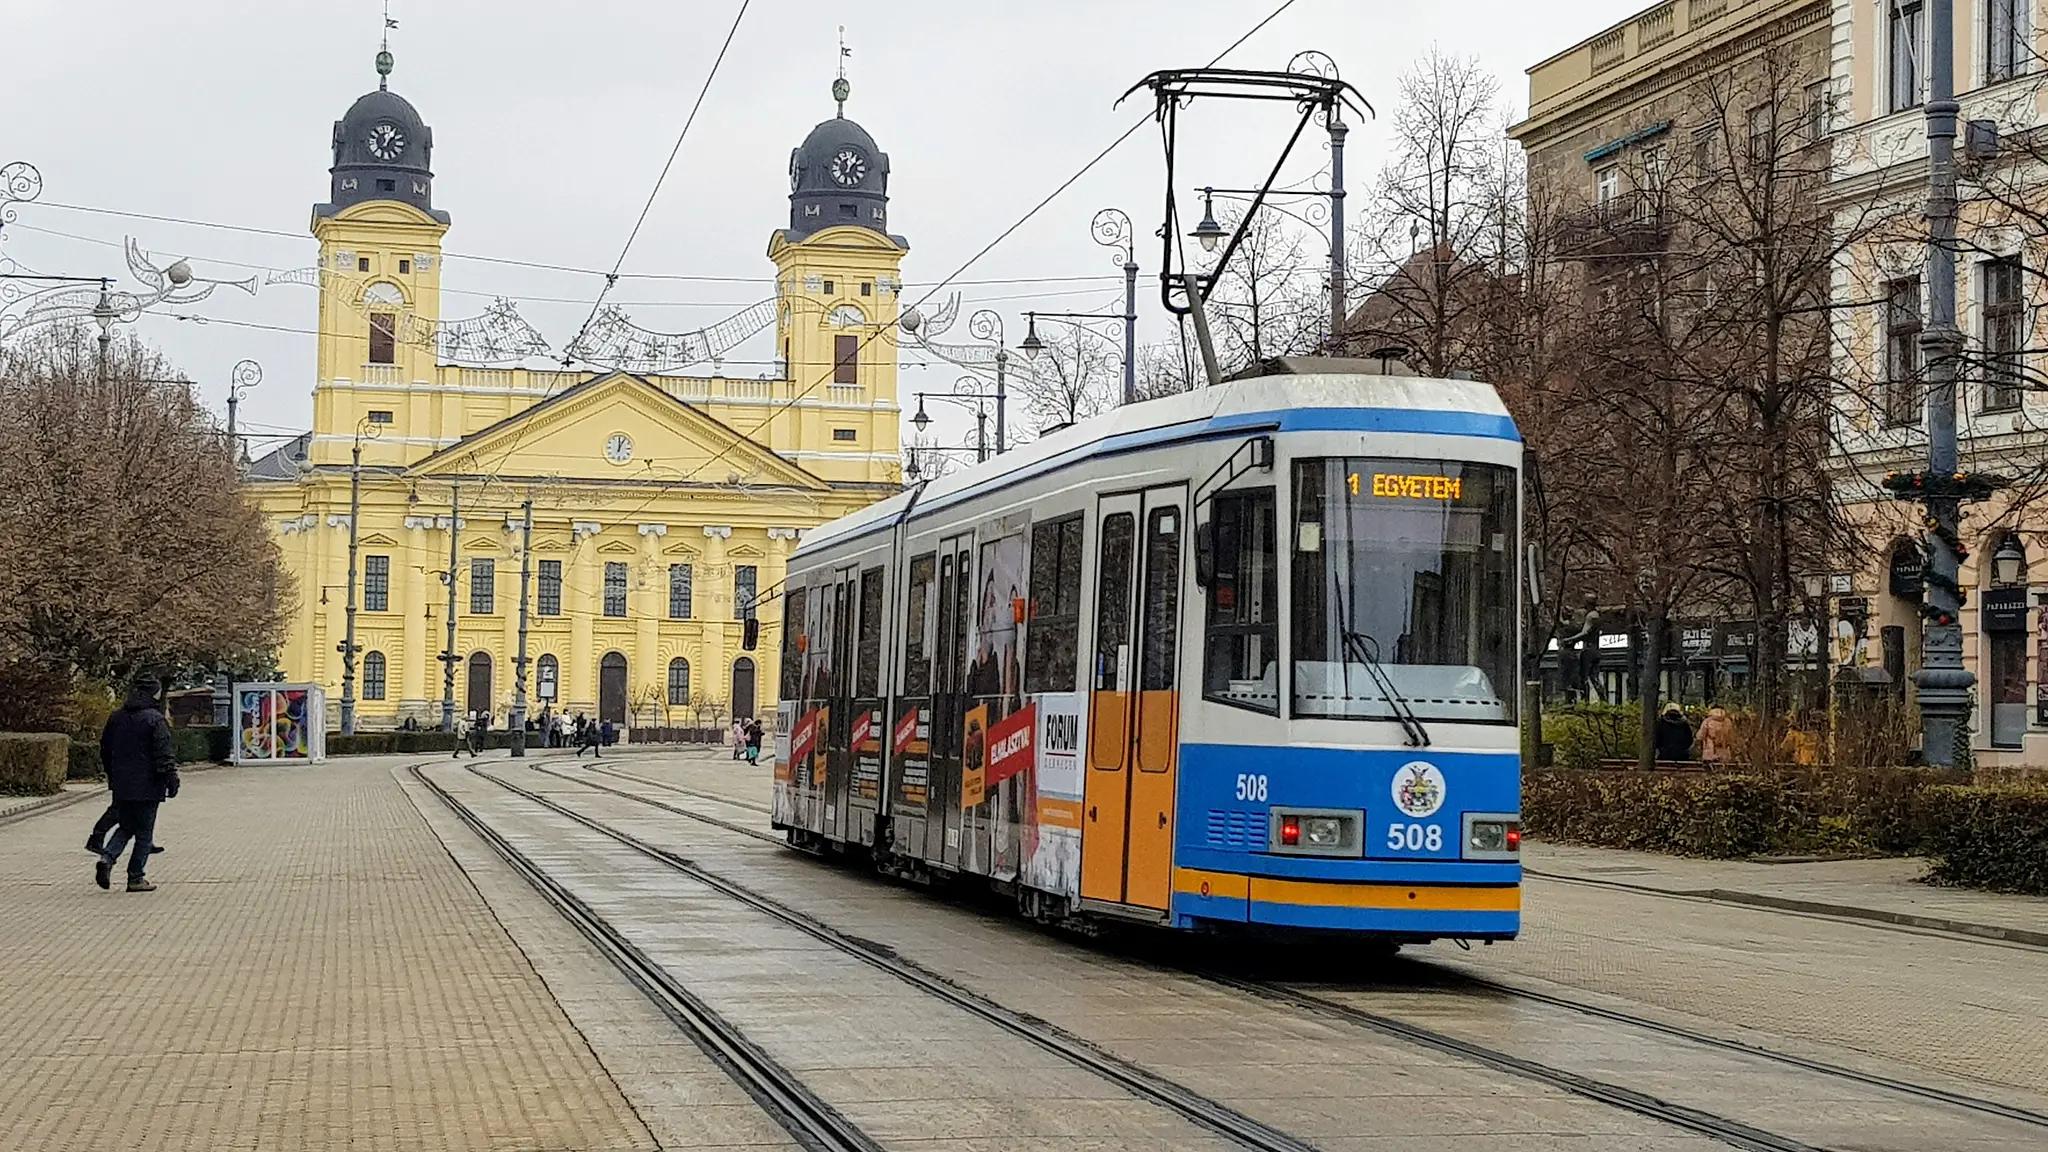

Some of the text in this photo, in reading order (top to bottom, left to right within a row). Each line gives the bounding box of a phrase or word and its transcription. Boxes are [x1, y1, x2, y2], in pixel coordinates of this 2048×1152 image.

[1347, 473, 1461, 499] 1 EGYETEM
[1045, 714, 1079, 750] FORUM
[1236, 773, 1268, 802] 508
[1387, 823, 1443, 851] 508
